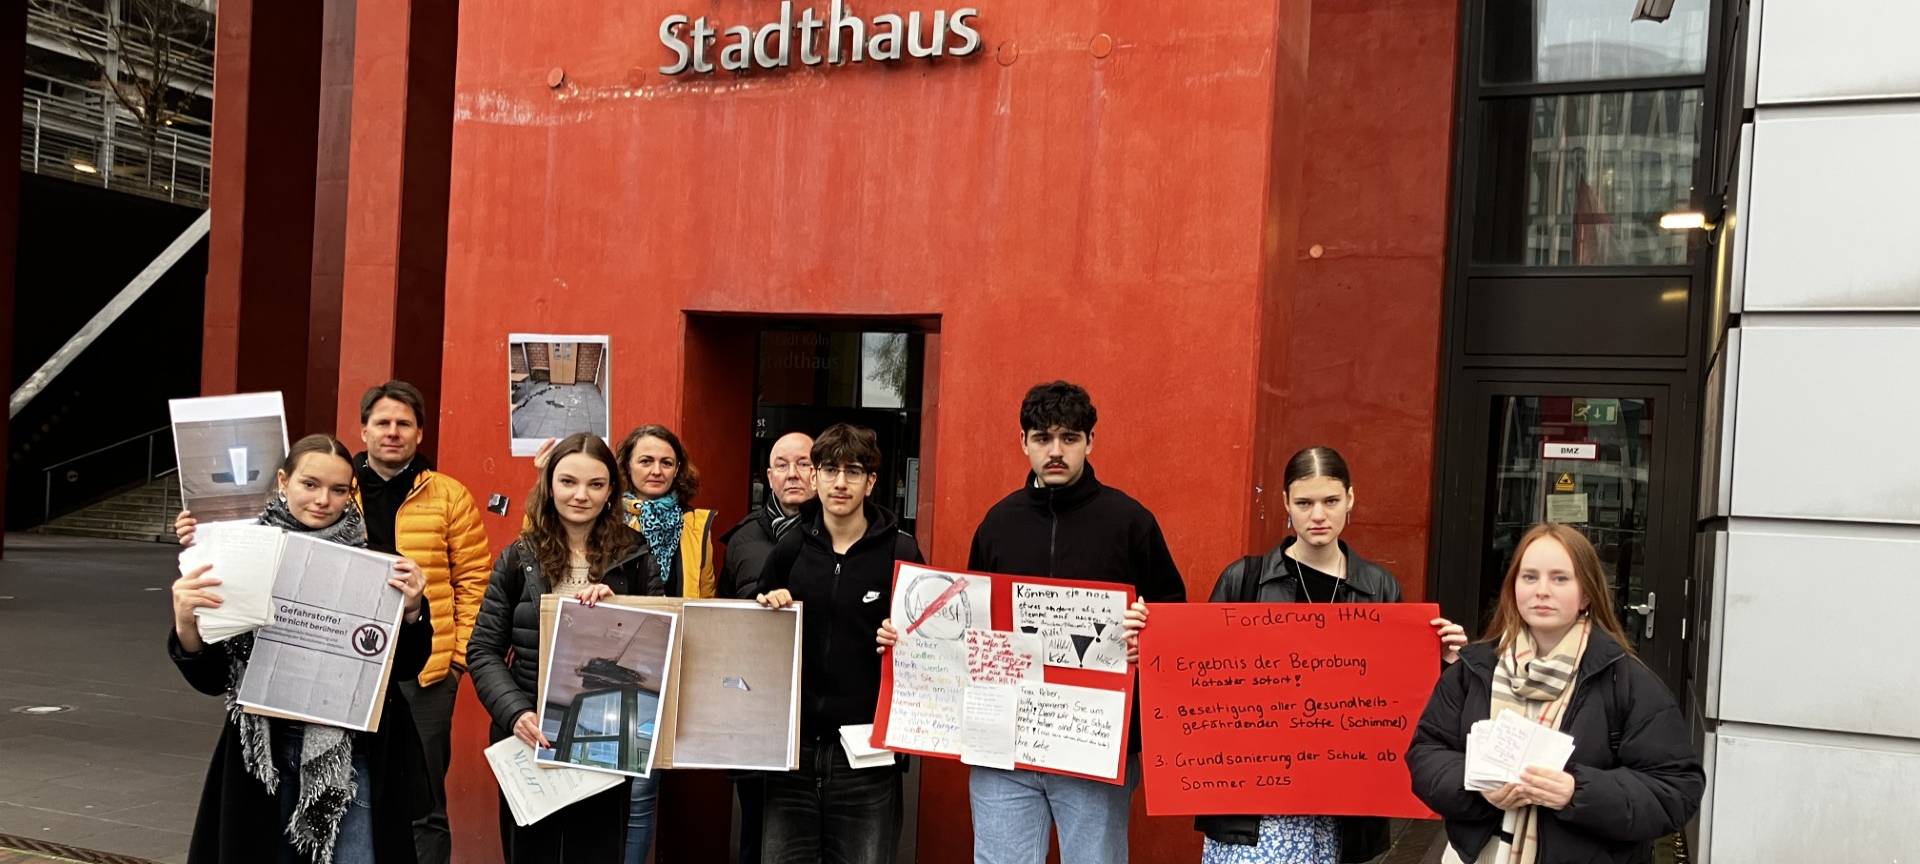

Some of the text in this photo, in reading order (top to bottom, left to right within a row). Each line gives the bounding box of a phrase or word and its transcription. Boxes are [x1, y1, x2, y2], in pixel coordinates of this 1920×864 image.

[659, 0, 981, 75] Stadthaus
[1017, 584, 1059, 599] Können
[1086, 591, 1110, 599] noch
[280, 605, 342, 625] Gefahrstoffe!
[1221, 607, 1381, 628] Forderung HMG
[288, 618, 309, 628] nicht
[309, 622, 348, 637] berühren!
[1150, 652, 1367, 676] 1. Ergebnis der Beprobung
[1191, 677, 1245, 687] Kataster
[1154, 708, 1168, 720] 2.
[1178, 702, 1263, 719] Beseitigung
[1270, 701, 1297, 712] aller
[1183, 714, 1408, 735] gefährdenden Stoffe (Schimmel)
[1154, 749, 1397, 769] 3. Grundsanierung der Schule ab
[1181, 775, 1292, 792] Sommer 2025
